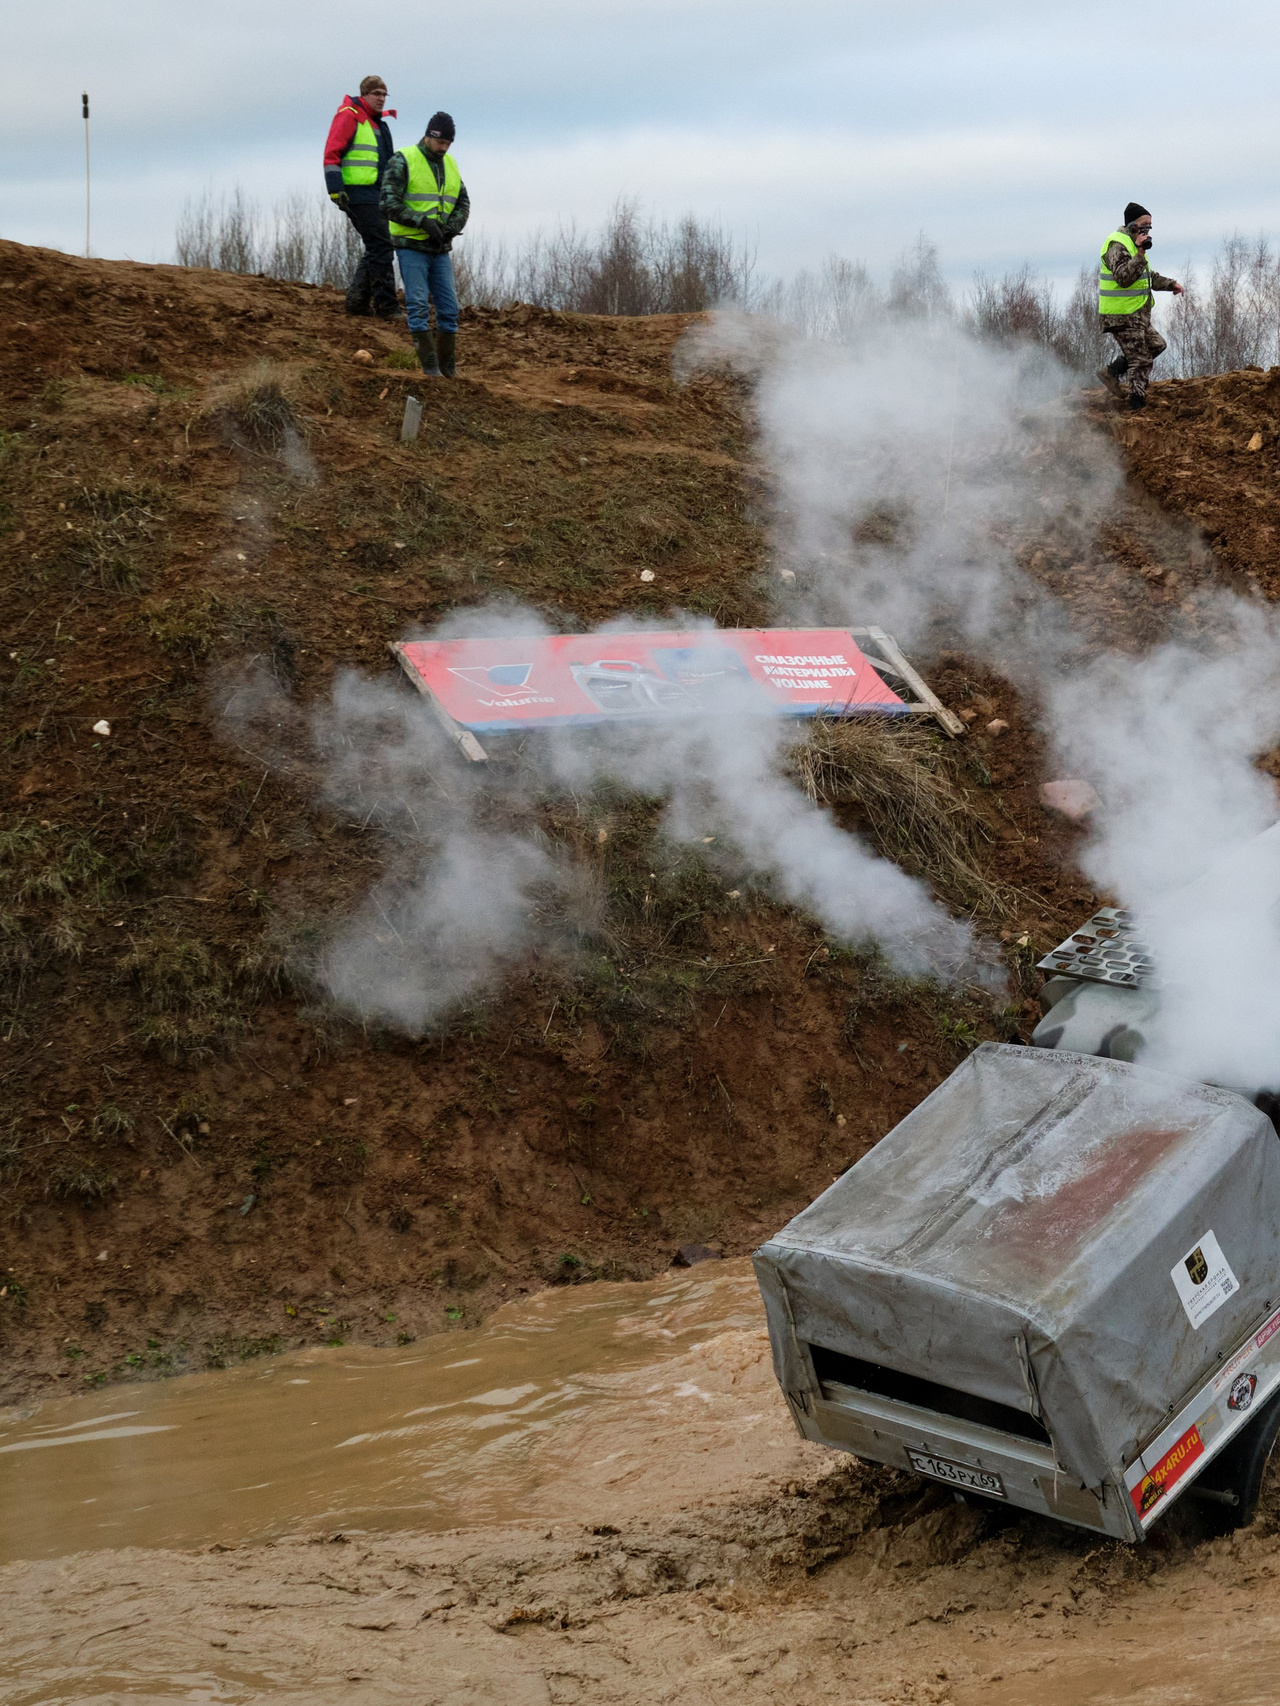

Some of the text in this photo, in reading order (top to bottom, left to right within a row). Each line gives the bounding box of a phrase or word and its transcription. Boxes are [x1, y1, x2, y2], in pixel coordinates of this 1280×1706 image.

[754, 654, 848, 666] СМАЗОЧНЫЕ
[762, 665, 857, 678] МАТЕРИАЛЫ
[770, 677, 833, 689] VOLUME
[477, 694, 556, 707] Volume
[1155, 1432, 1199, 1483] 4x4RU.ru
